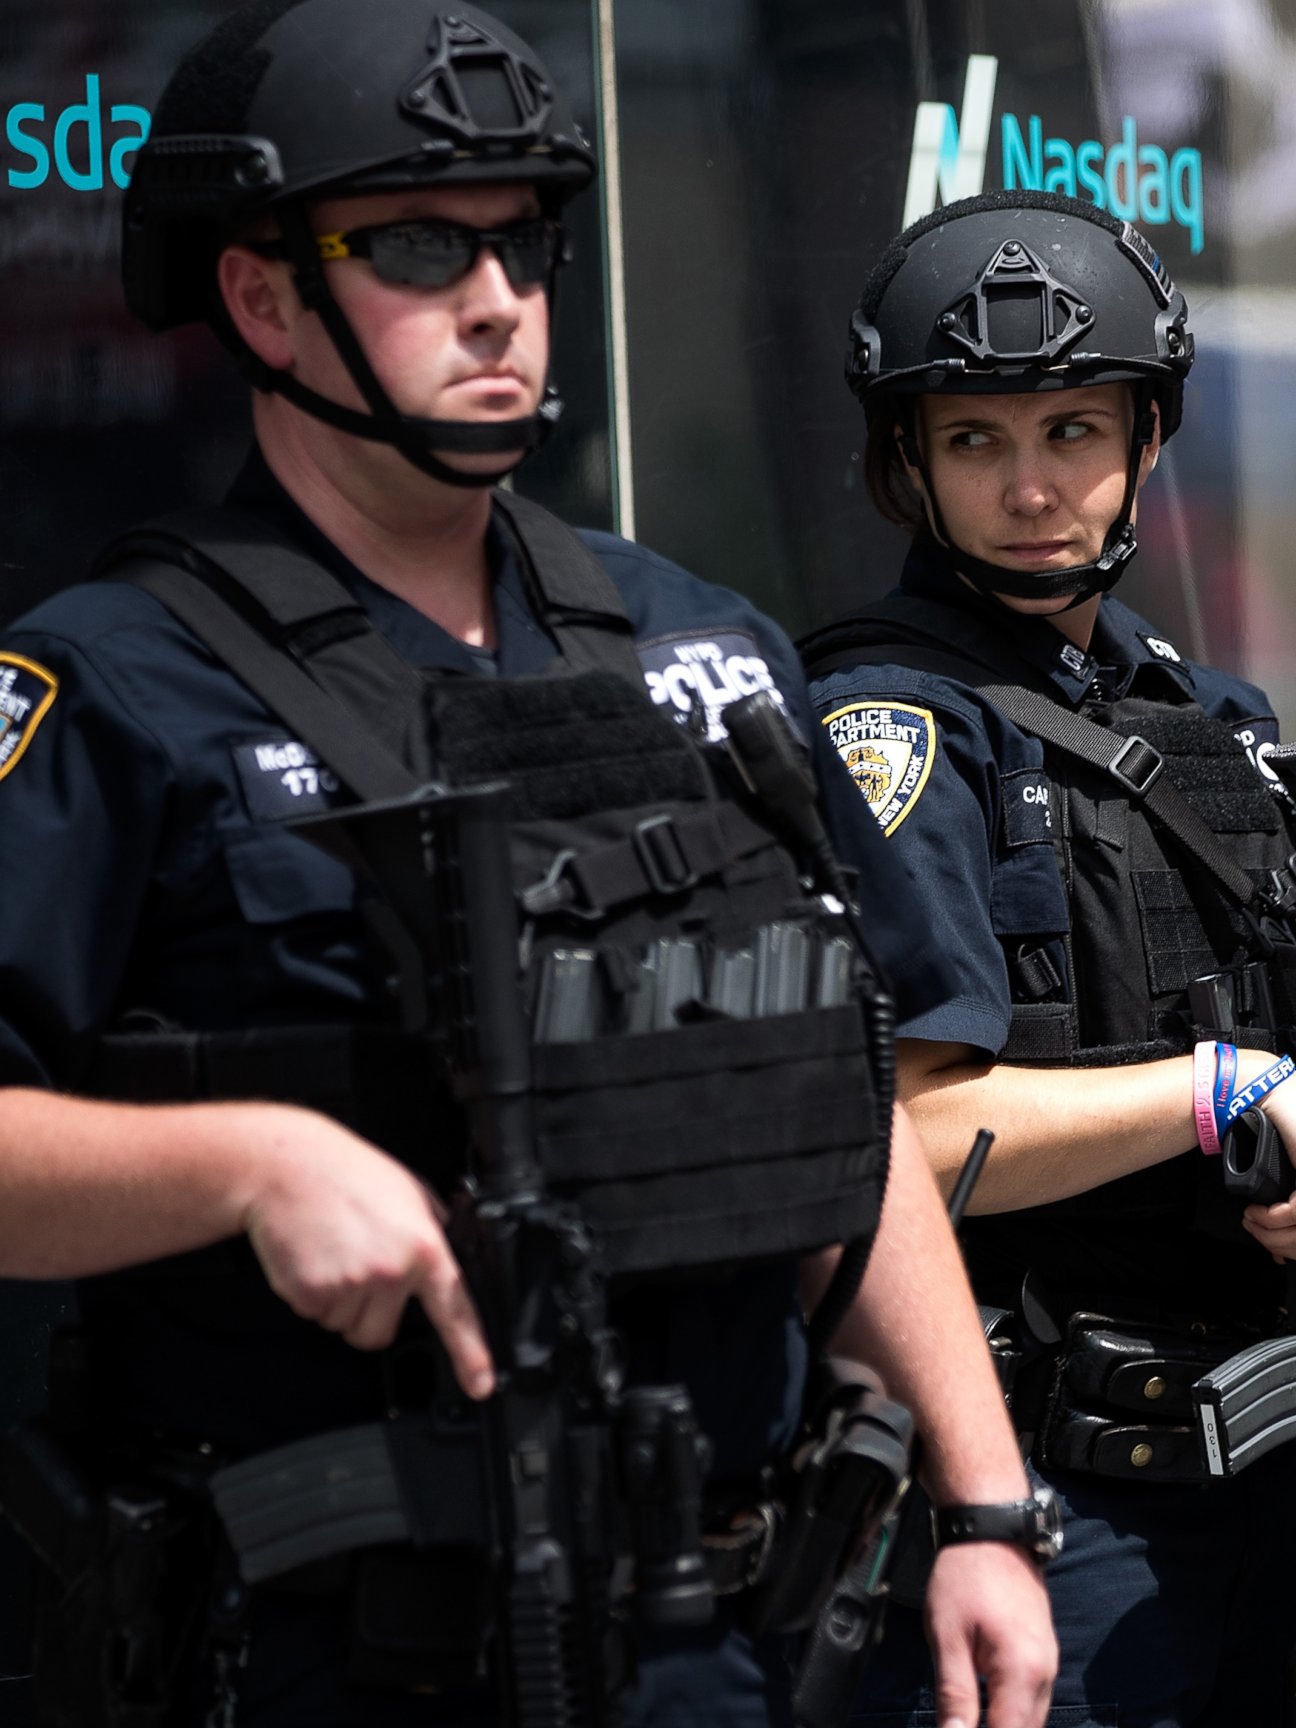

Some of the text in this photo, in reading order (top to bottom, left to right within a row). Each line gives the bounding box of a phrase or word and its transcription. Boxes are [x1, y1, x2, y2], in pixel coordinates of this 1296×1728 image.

[1001, 112, 1204, 255] Nasdaq
[829, 709, 893, 737] POLICE
[896, 754, 925, 795] YORK
[1199, 1111, 1216, 1152] FAITH
